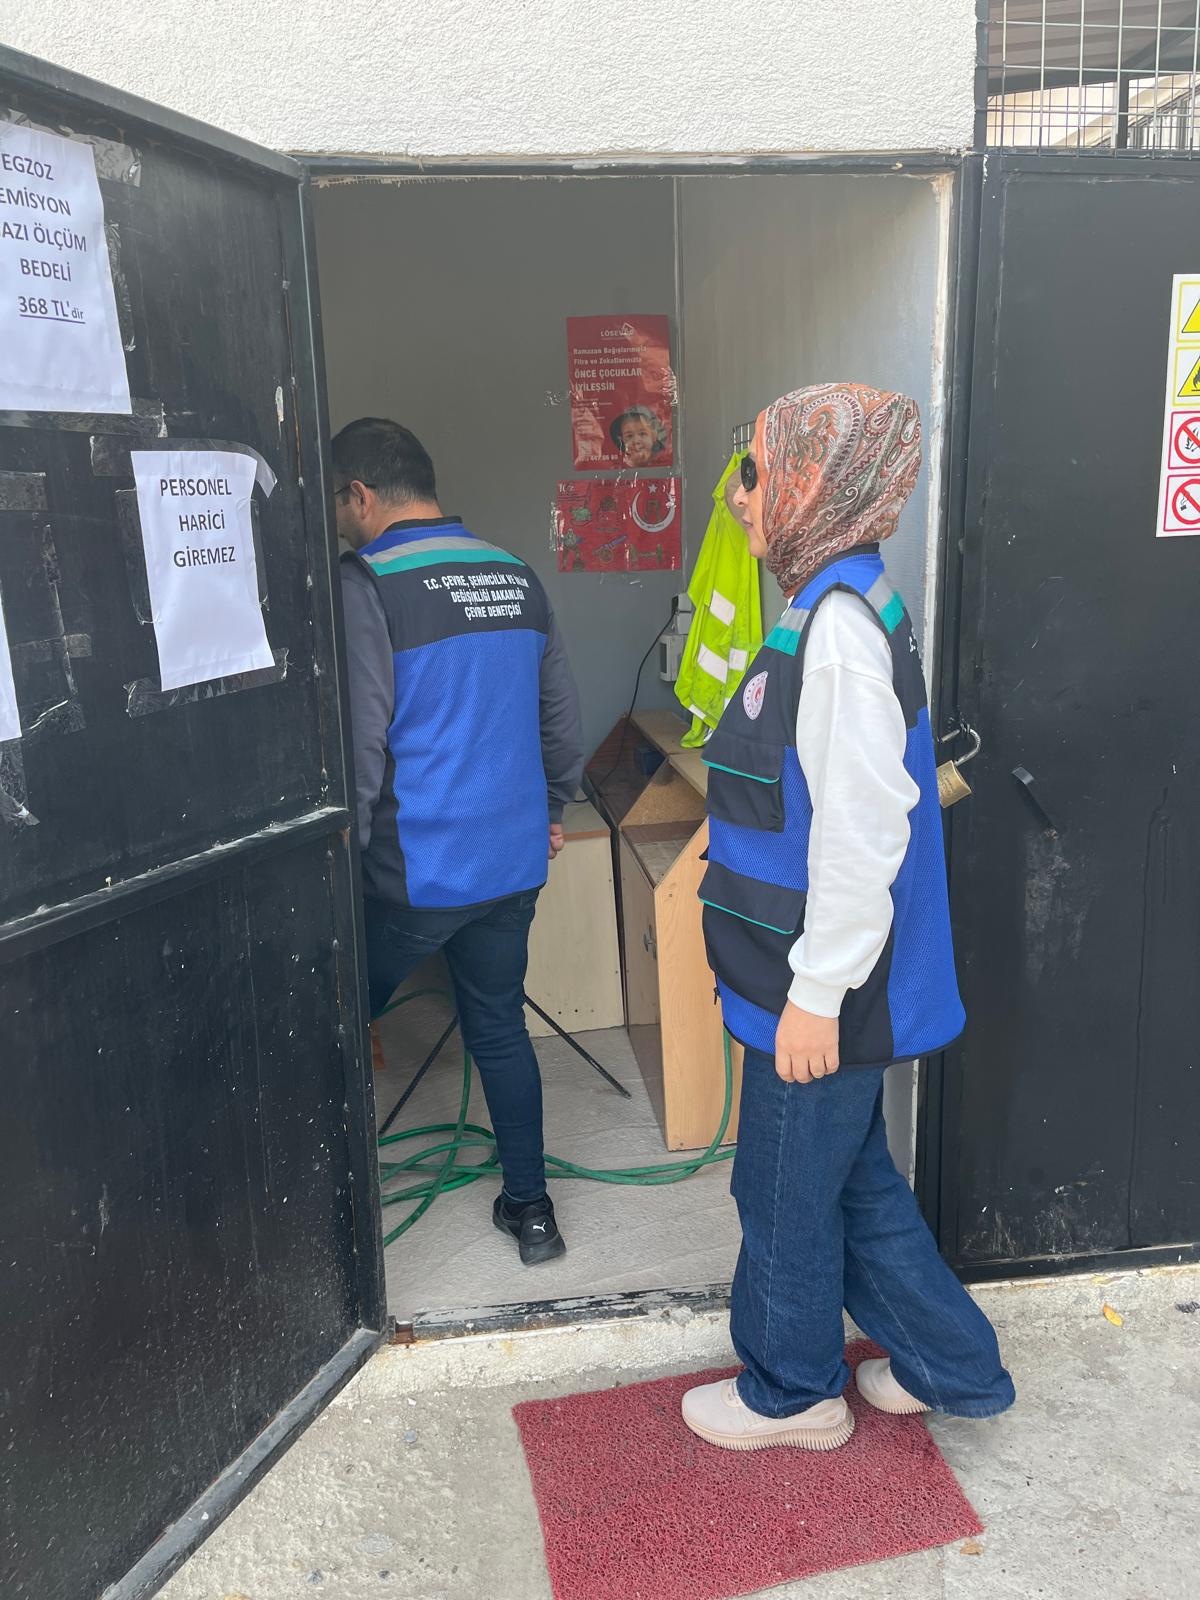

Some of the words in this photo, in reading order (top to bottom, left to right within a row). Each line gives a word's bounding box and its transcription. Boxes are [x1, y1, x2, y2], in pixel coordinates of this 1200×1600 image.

[2, 153, 54, 181] EGZOZ
[33, 223, 87, 252] ÖLÇÜM
[20, 258, 72, 282] BEDELİ
[18, 296, 48, 316] 368
[574, 368, 597, 379] ÖNCE
[599, 367, 642, 379] ÇOCUKLAR
[160, 478, 232, 496] PERSONEL
[178, 509, 225, 532] HARİCİ
[173, 545, 236, 568] GİREMEZ
[423, 579, 442, 590] T.C.
[441, 575, 470, 590] ÇEVRE,
[468, 572, 508, 588] ŞEHİRCİLİK
[450, 588, 491, 605] DEĞİŞİKLİĞİ
[464, 606, 487, 620] ÇEVRE
[487, 602, 522, 618] DENETÇİSİ
